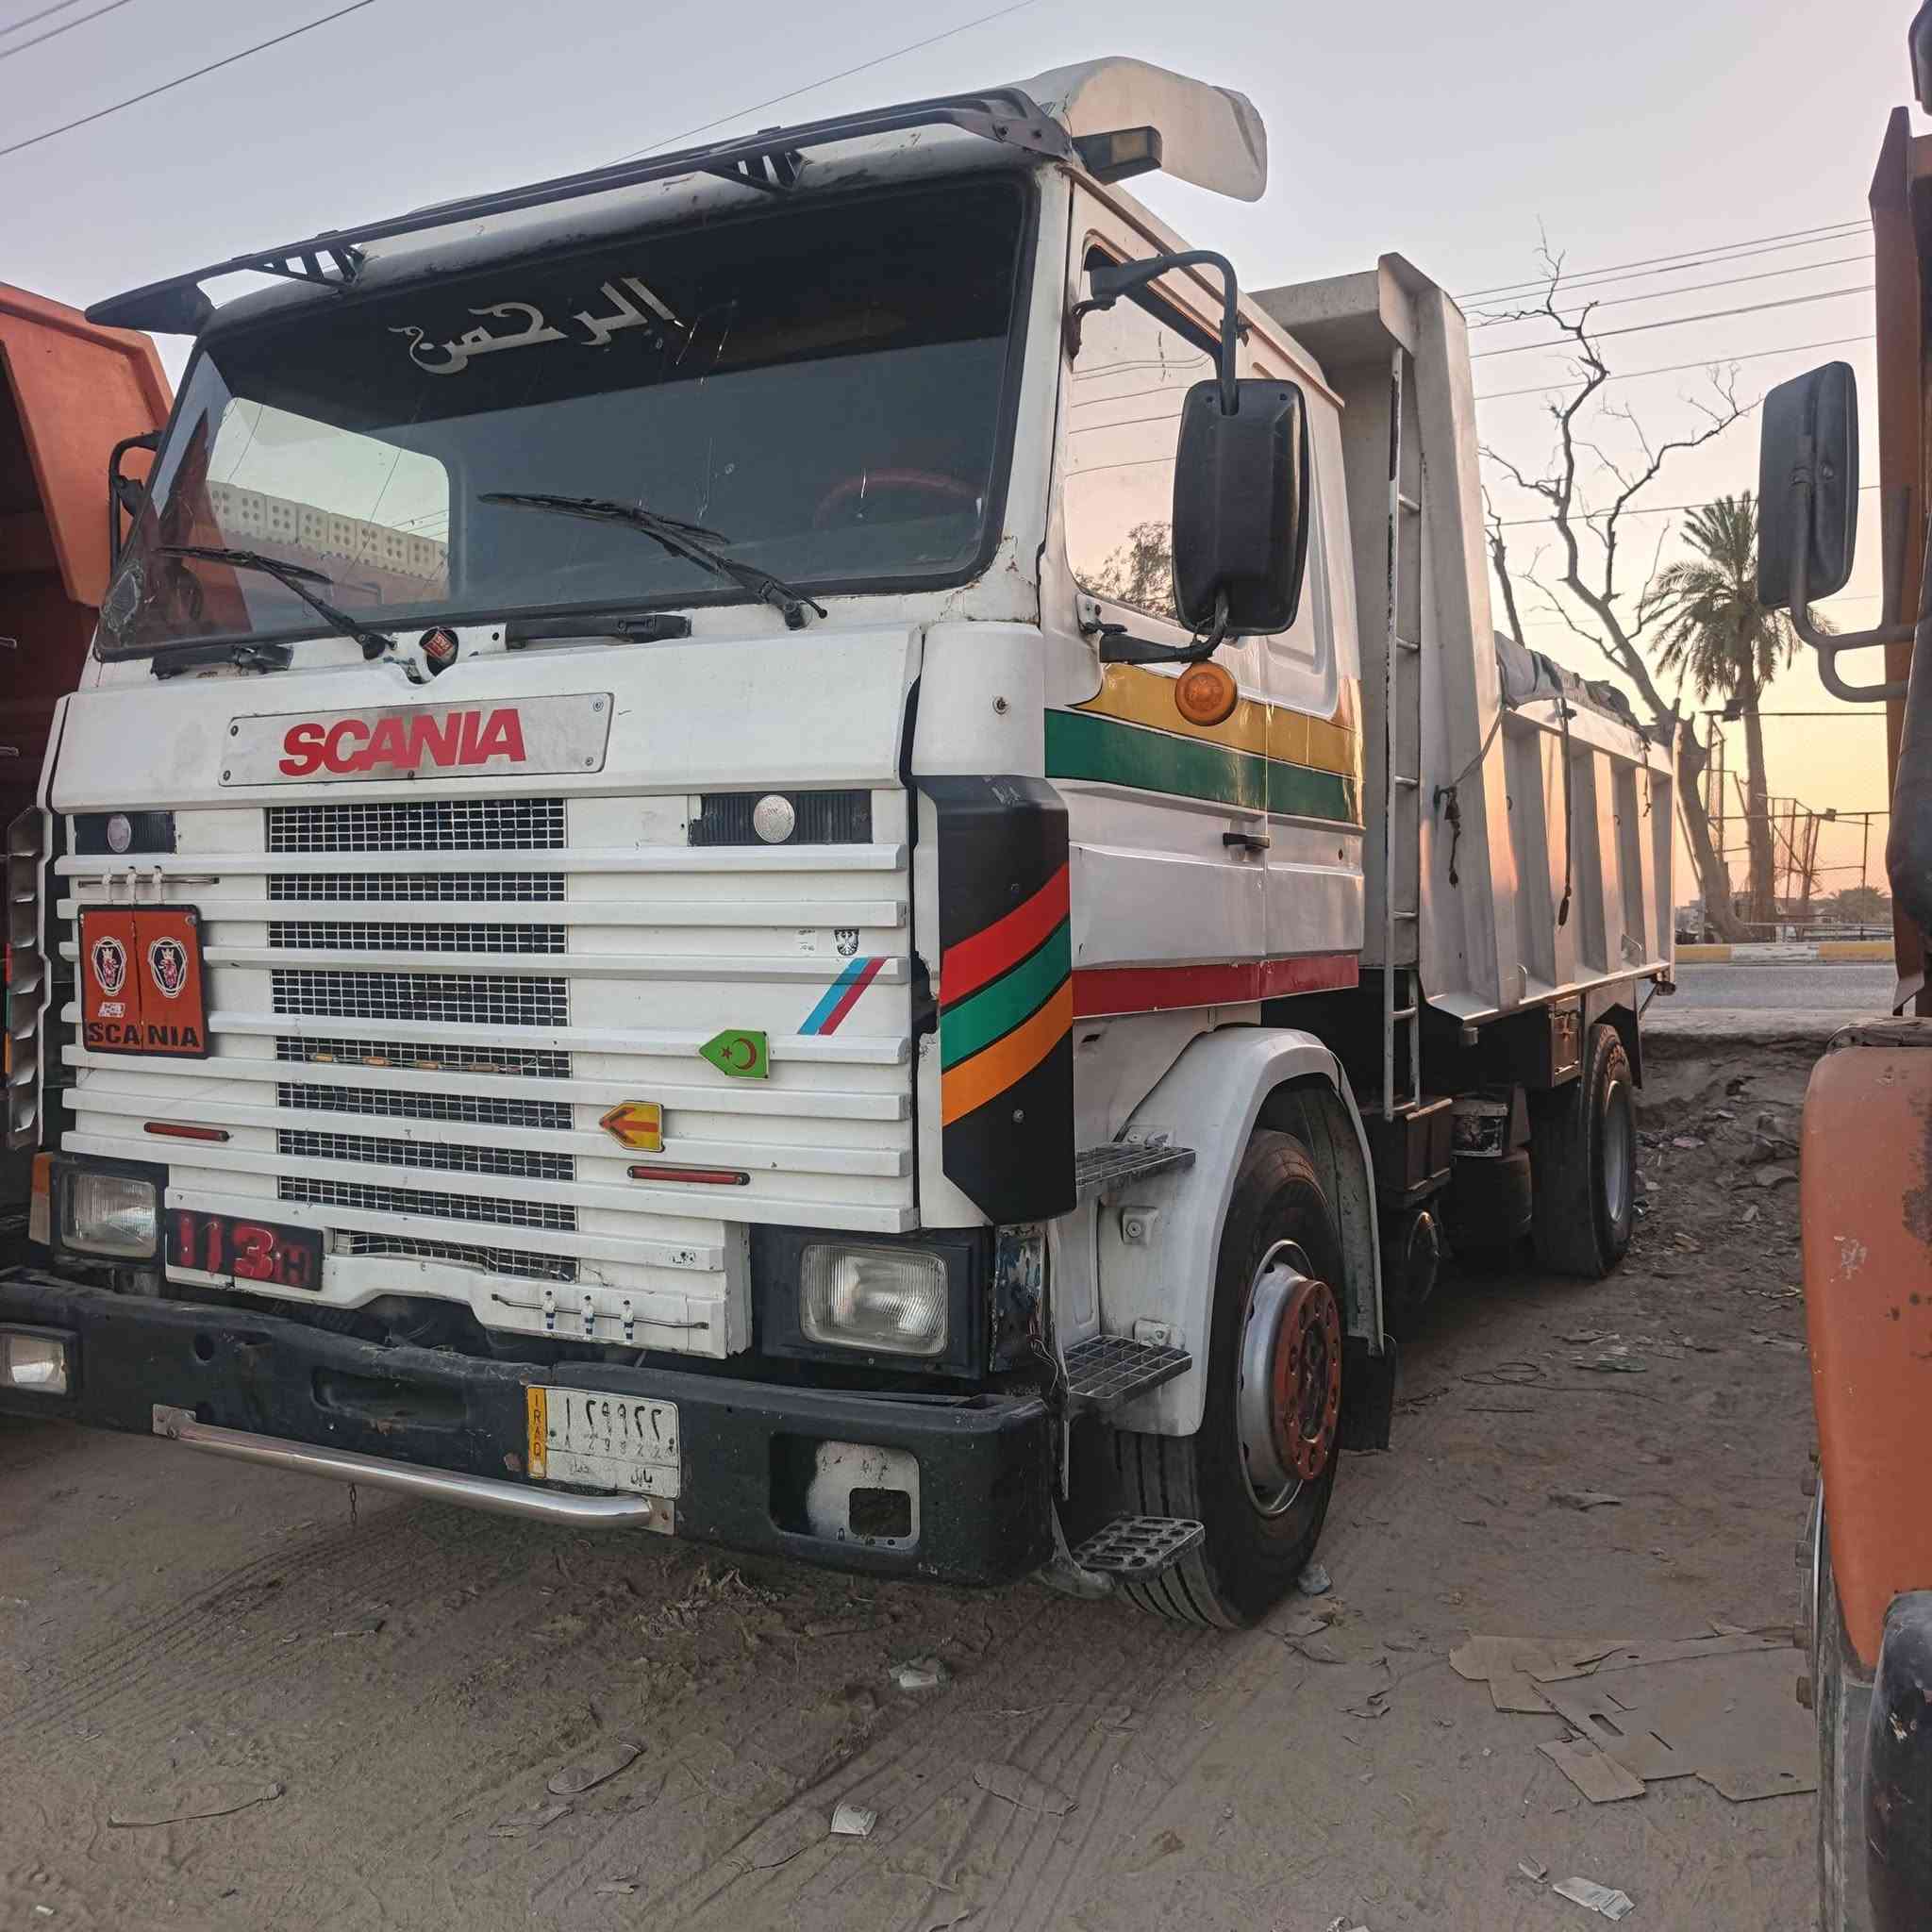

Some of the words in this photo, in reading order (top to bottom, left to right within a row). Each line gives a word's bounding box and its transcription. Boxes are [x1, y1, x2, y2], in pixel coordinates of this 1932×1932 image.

[388, 278, 680, 375] الرحمن
[278, 708, 527, 777] SCANIA
[88, 1022, 200, 1047] SCANIA
[533, 1393, 541, 1457] IRAQ
